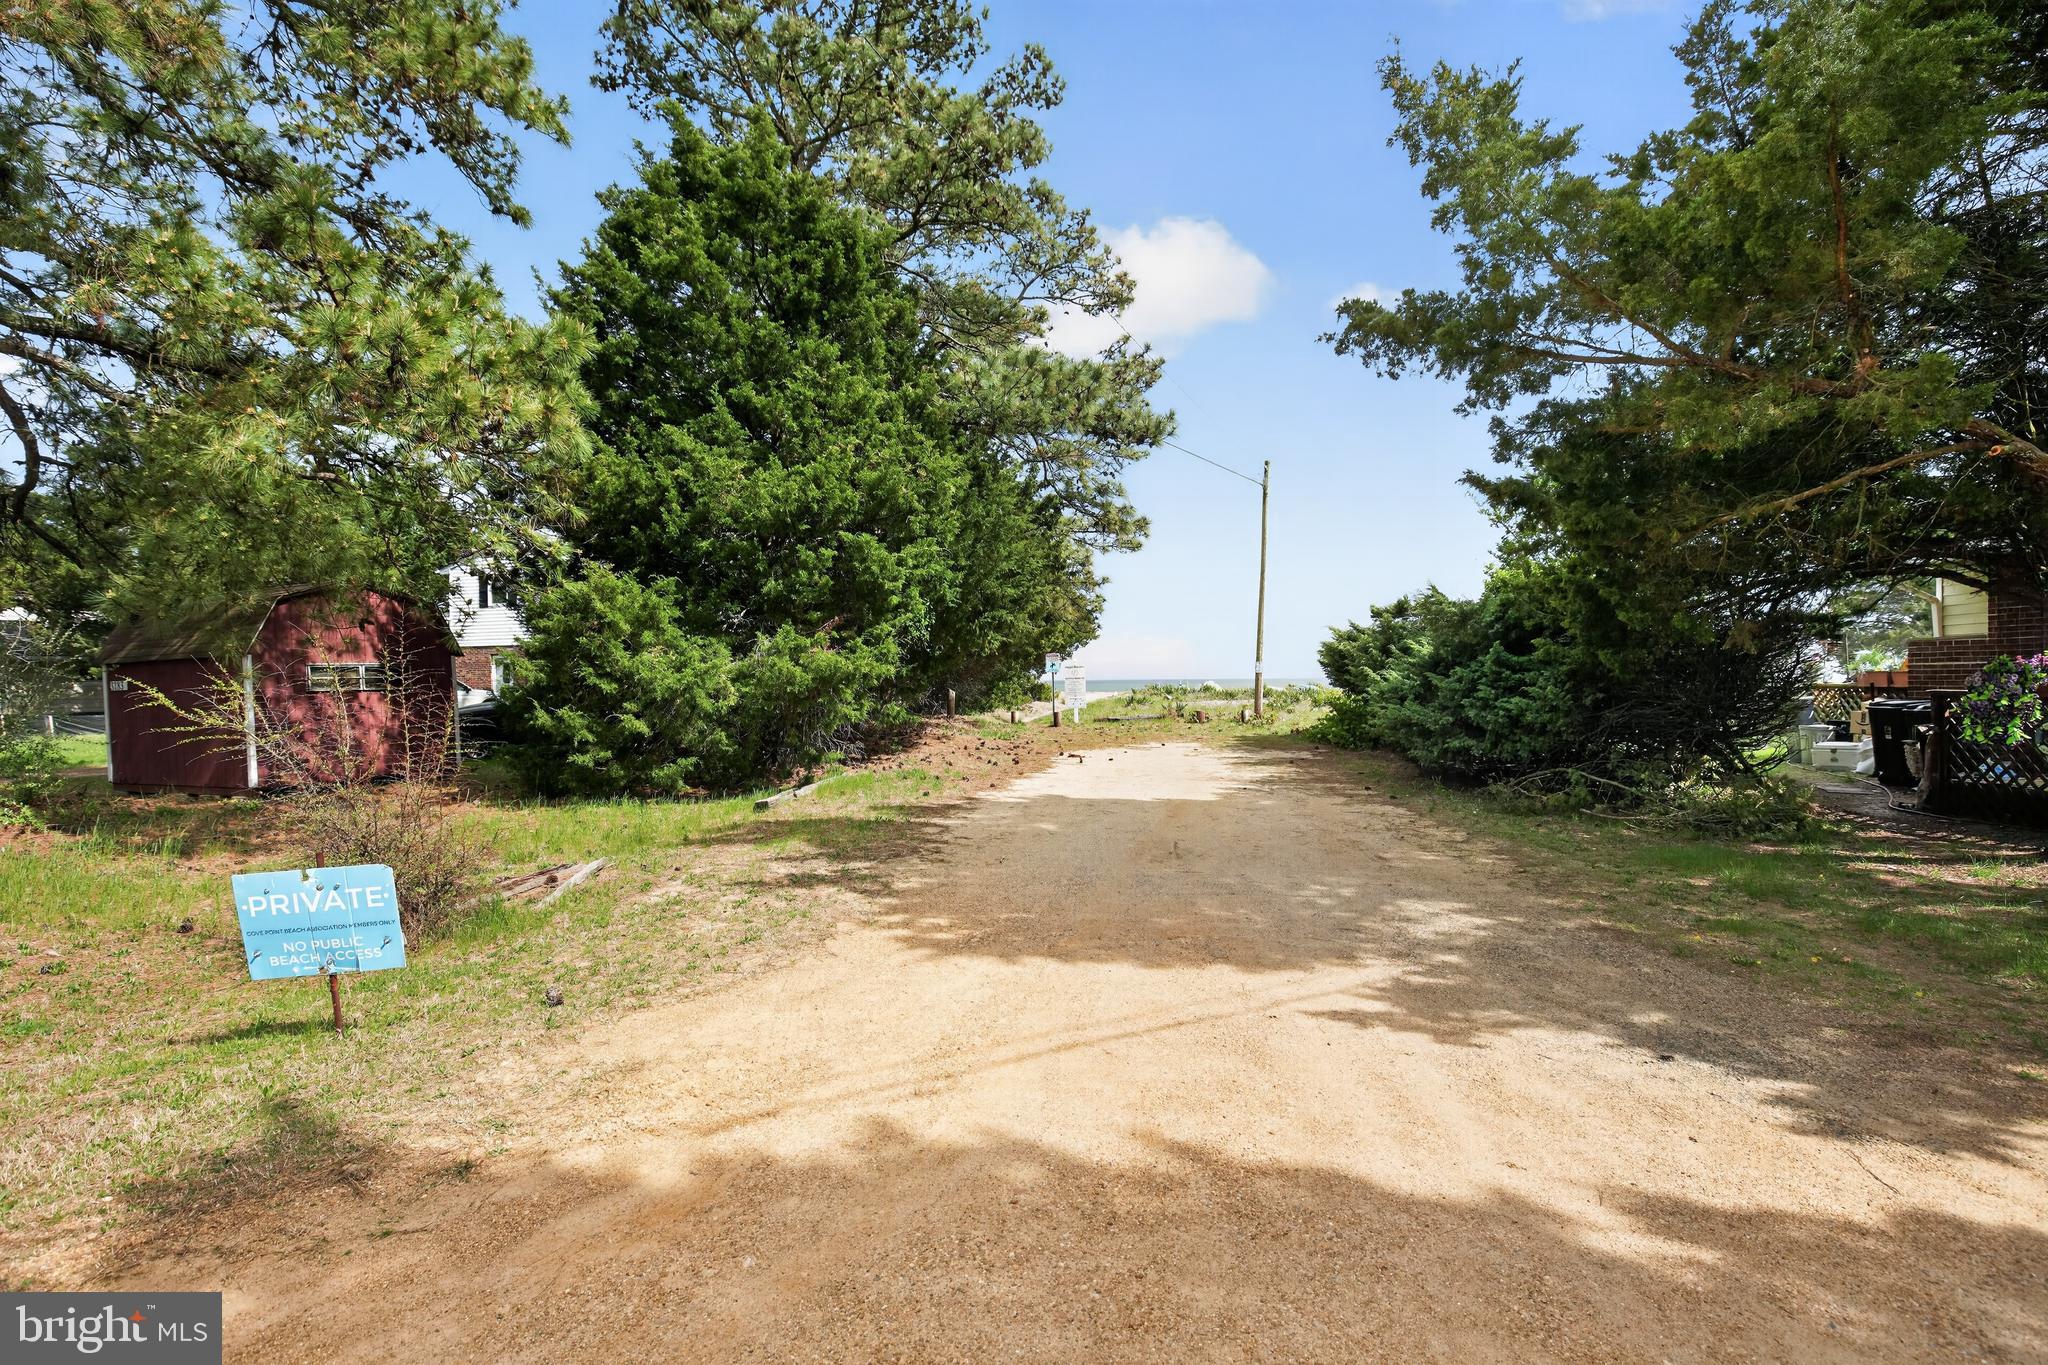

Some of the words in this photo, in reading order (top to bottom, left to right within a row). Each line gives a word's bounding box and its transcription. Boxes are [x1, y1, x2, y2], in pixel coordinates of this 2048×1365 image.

[248, 886, 385, 918] PRIVATE
[306, 923, 348, 932] ASSOCIATION
[348, 921, 378, 929] MEMBERS
[283, 941, 307, 953] NO
[311, 936, 365, 950] PUBLIC
[269, 952, 321, 967] BEACH
[325, 947, 383, 962] ACCESS
